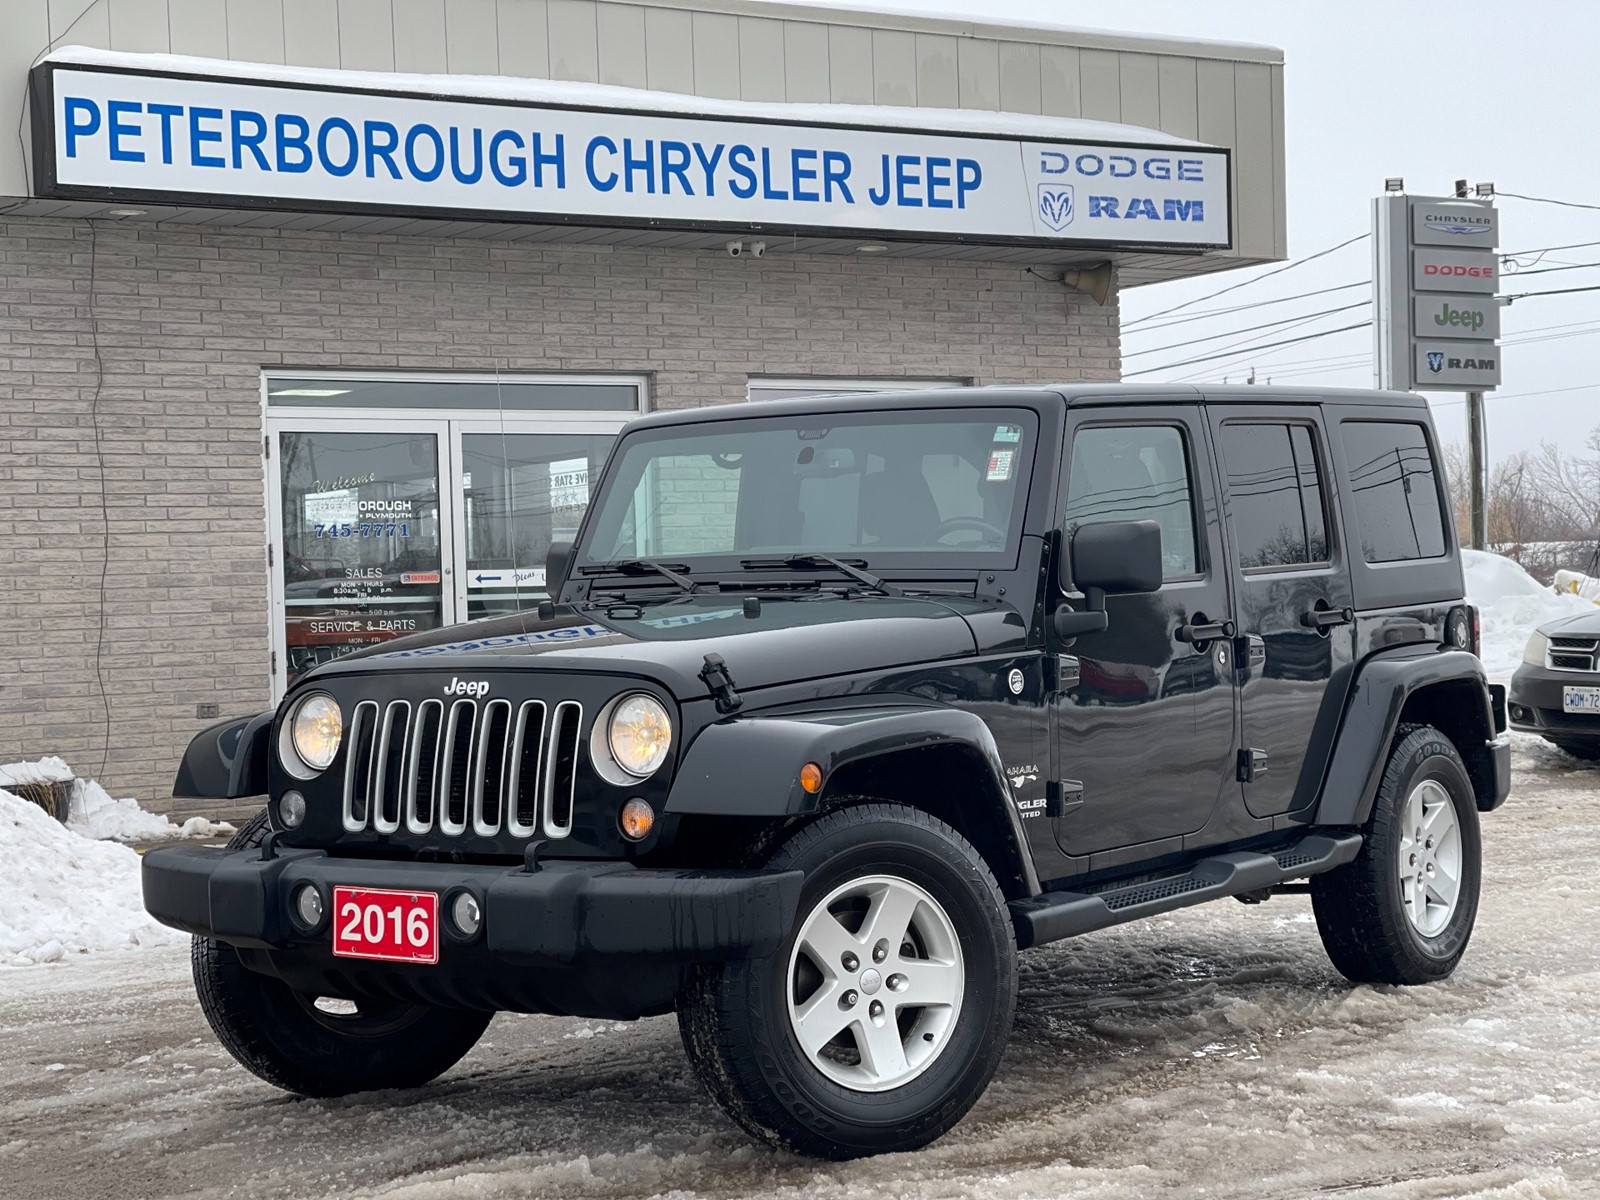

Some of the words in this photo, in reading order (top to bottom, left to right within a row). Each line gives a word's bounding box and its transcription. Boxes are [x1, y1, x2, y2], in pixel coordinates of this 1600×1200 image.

[64, 96, 566, 189] PETERBOROUGH
[585, 135, 855, 204] CHRYSLER
[868, 154, 982, 209] JEEP
[1041, 151, 1204, 182] DODGE
[1089, 195, 1204, 222] RAM
[1425, 214, 1491, 225] CHRYSLER
[1424, 264, 1493, 278] DODGE
[1434, 303, 1484, 332] Jeep
[1448, 357, 1495, 370] RAM
[312, 472, 376, 494] Welcome
[358, 500, 412, 511] OROUGH
[314, 523, 409, 539] 745-7771
[345, 567, 383, 579] SALES
[310, 621, 360, 634] SERVICE
[380, 619, 416, 631] PARTS
[443, 677, 490, 698] Jeep
[1564, 693, 1585, 707] CWDM
[1006, 764, 1039, 775] AHARA
[1017, 798, 1048, 810] GLER
[1021, 810, 1041, 819] ITED
[340, 902, 430, 947] 2016
